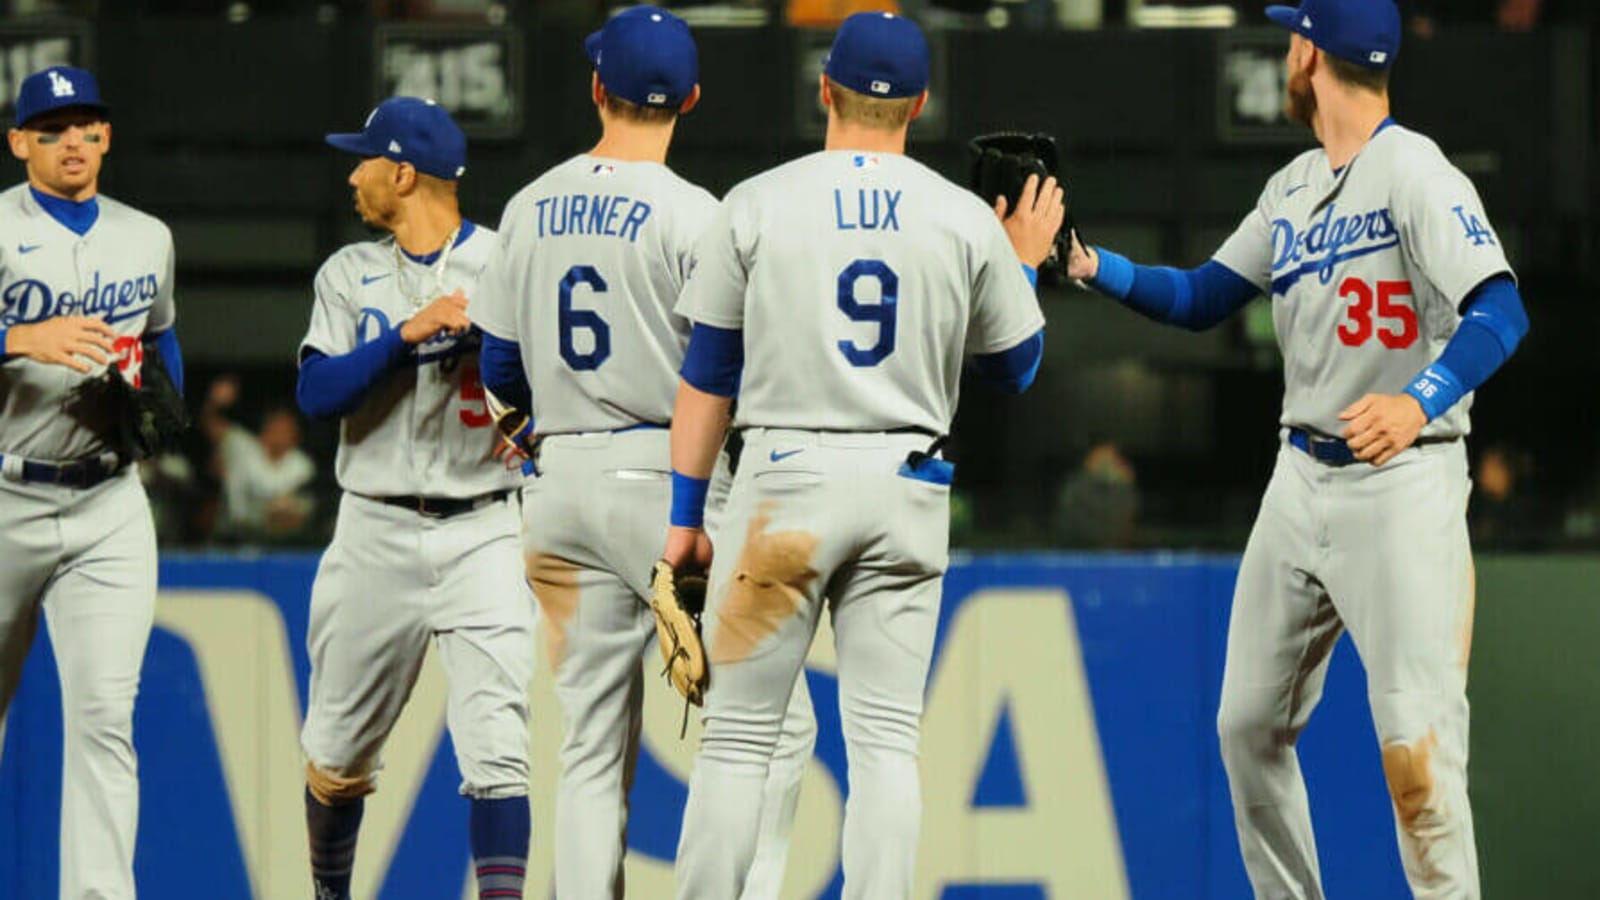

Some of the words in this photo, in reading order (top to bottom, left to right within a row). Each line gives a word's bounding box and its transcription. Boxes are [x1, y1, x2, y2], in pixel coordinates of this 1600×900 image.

[48, 71, 76, 97] LA
[536, 195, 651, 243] TURNER
[835, 189, 902, 231] LUX
[1453, 206, 1495, 246] LA
[3, 272, 158, 327] Dodgers
[558, 265, 611, 371] 6
[837, 259, 899, 367] 9
[1337, 277, 1419, 350] 35
